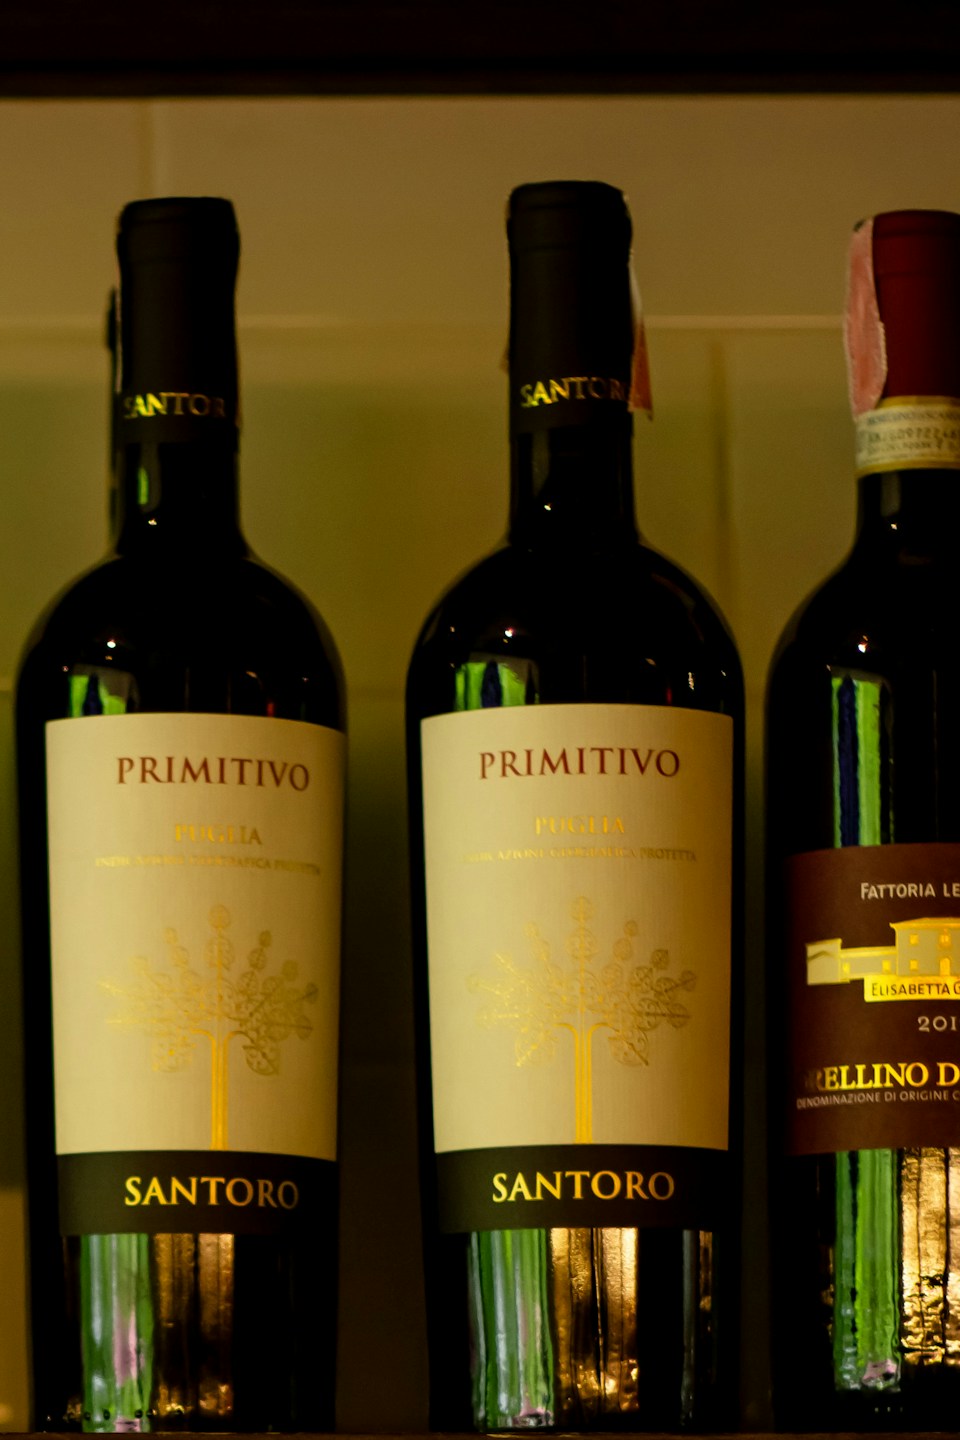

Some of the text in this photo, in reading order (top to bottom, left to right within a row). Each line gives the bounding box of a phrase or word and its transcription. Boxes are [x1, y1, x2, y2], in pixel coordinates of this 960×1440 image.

[116, 756, 310, 792] PRIMITIVO
[478, 747, 680, 779] PRIMITIVO
[860, 882, 936, 900] FATTORIA
[871, 983, 950, 997] ELISABETTA
[797, 1092, 880, 1110] DENOMINAZIONE
[884, 1091, 896, 1102] DI
[899, 1090, 949, 1102] ORIGINE
[124, 1175, 299, 1210] SANTORO
[492, 1169, 675, 1202] SANTORO
